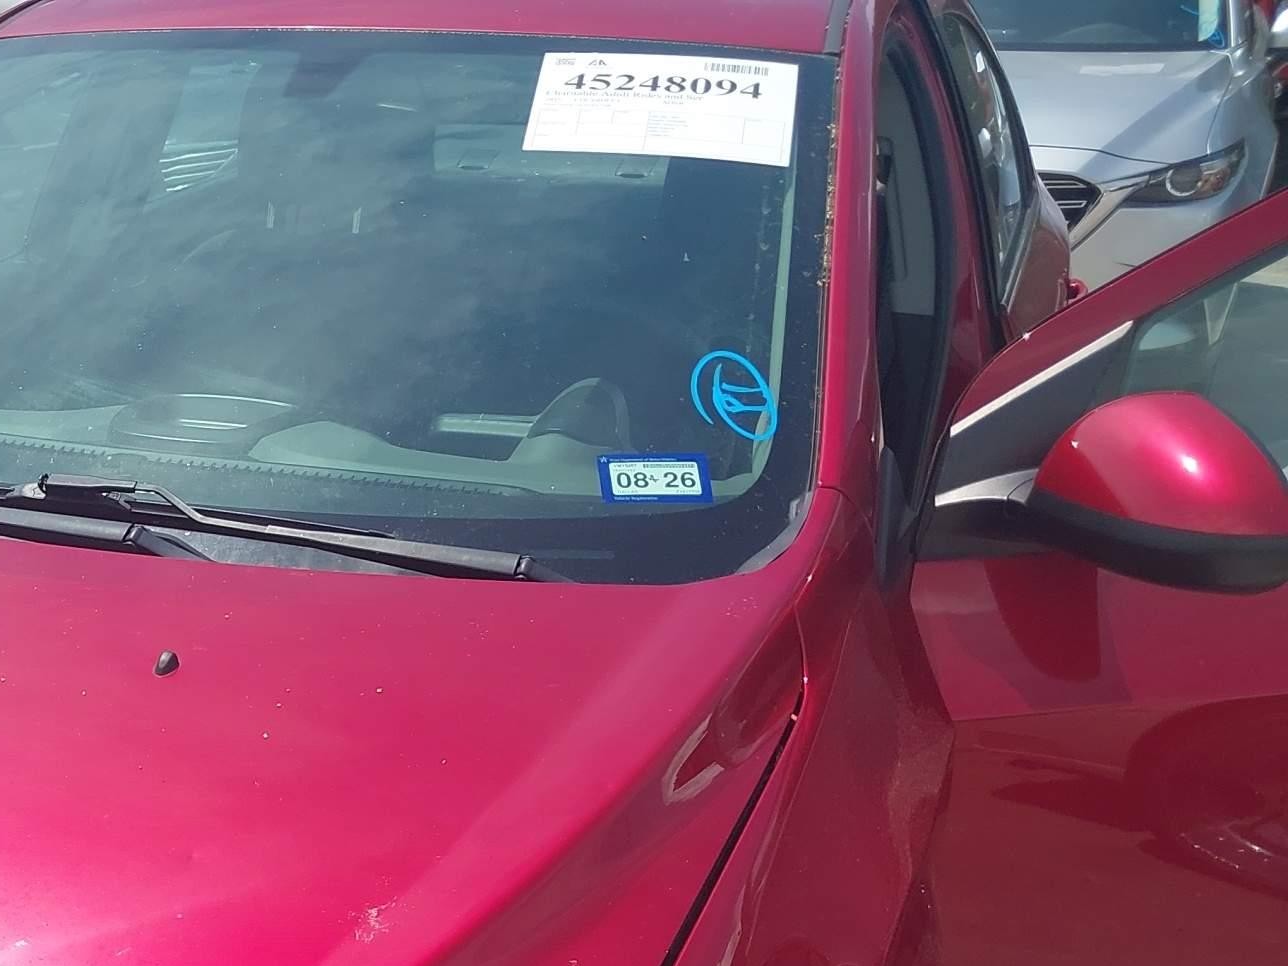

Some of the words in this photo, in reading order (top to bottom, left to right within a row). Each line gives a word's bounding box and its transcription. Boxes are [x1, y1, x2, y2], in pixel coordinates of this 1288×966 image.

[564, 73, 762, 99] 45248094
[616, 471, 649, 489] 08
[663, 471, 697, 488] 26
